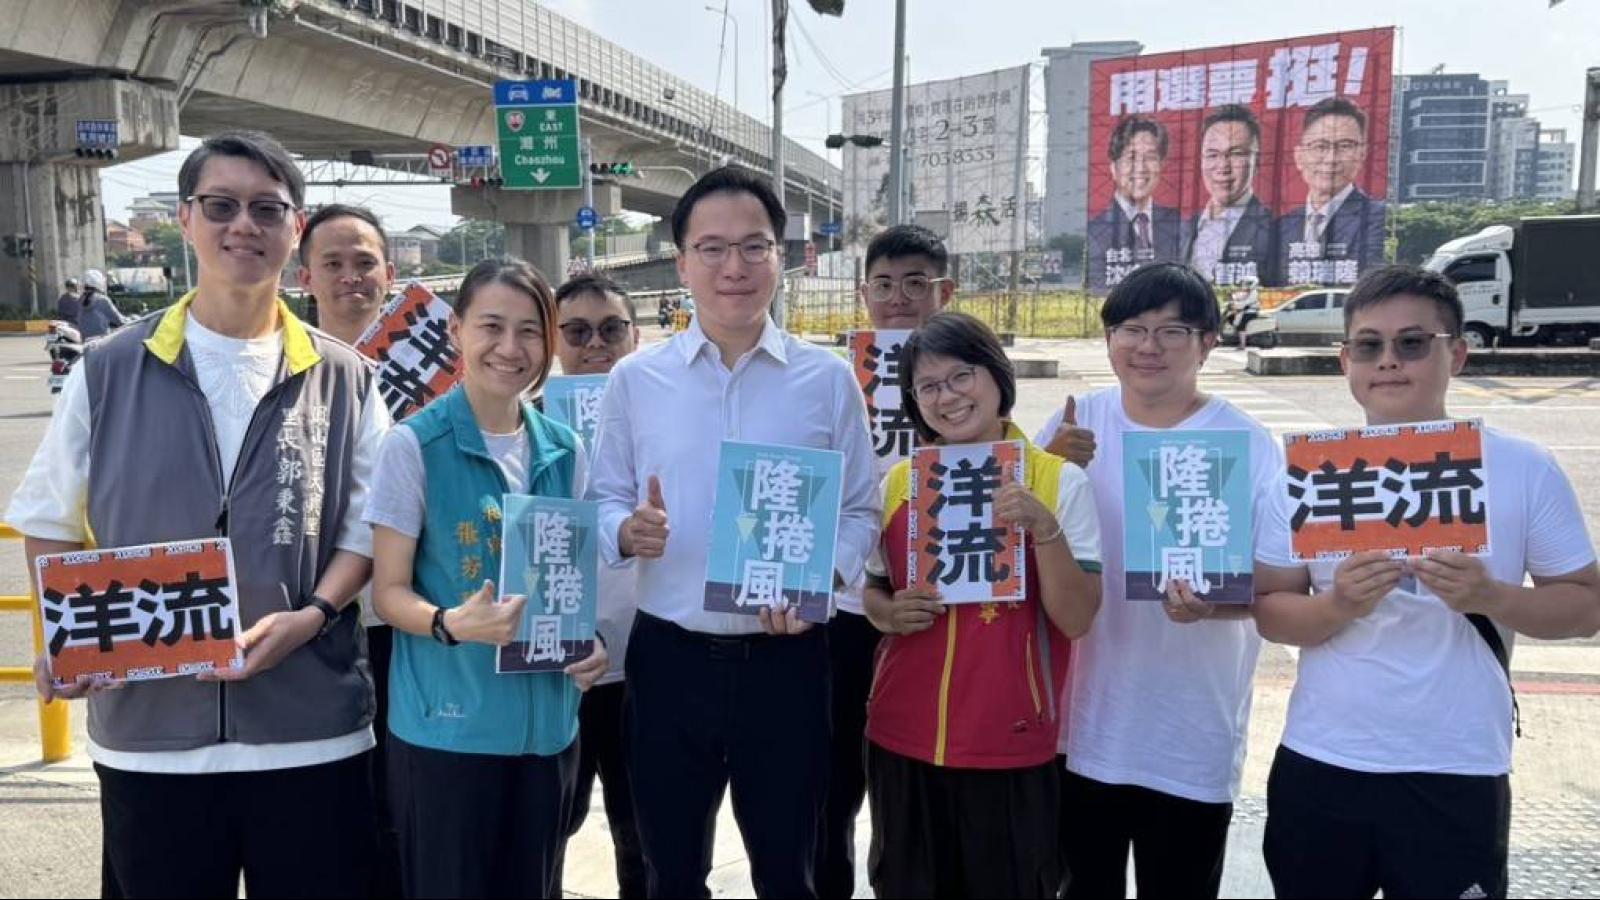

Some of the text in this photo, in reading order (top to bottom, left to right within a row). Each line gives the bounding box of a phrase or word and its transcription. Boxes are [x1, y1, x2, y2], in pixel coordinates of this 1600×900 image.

[540, 122, 563, 132] EAST
[735, 459, 814, 609] 隆捲風
[925, 455, 1010, 586] 洋流
[1157, 445, 1231, 594] 隆捲風
[1288, 451, 1485, 532] 洋流
[44, 571, 235, 657] 洋流
[525, 512, 583, 664] 隆捲風
